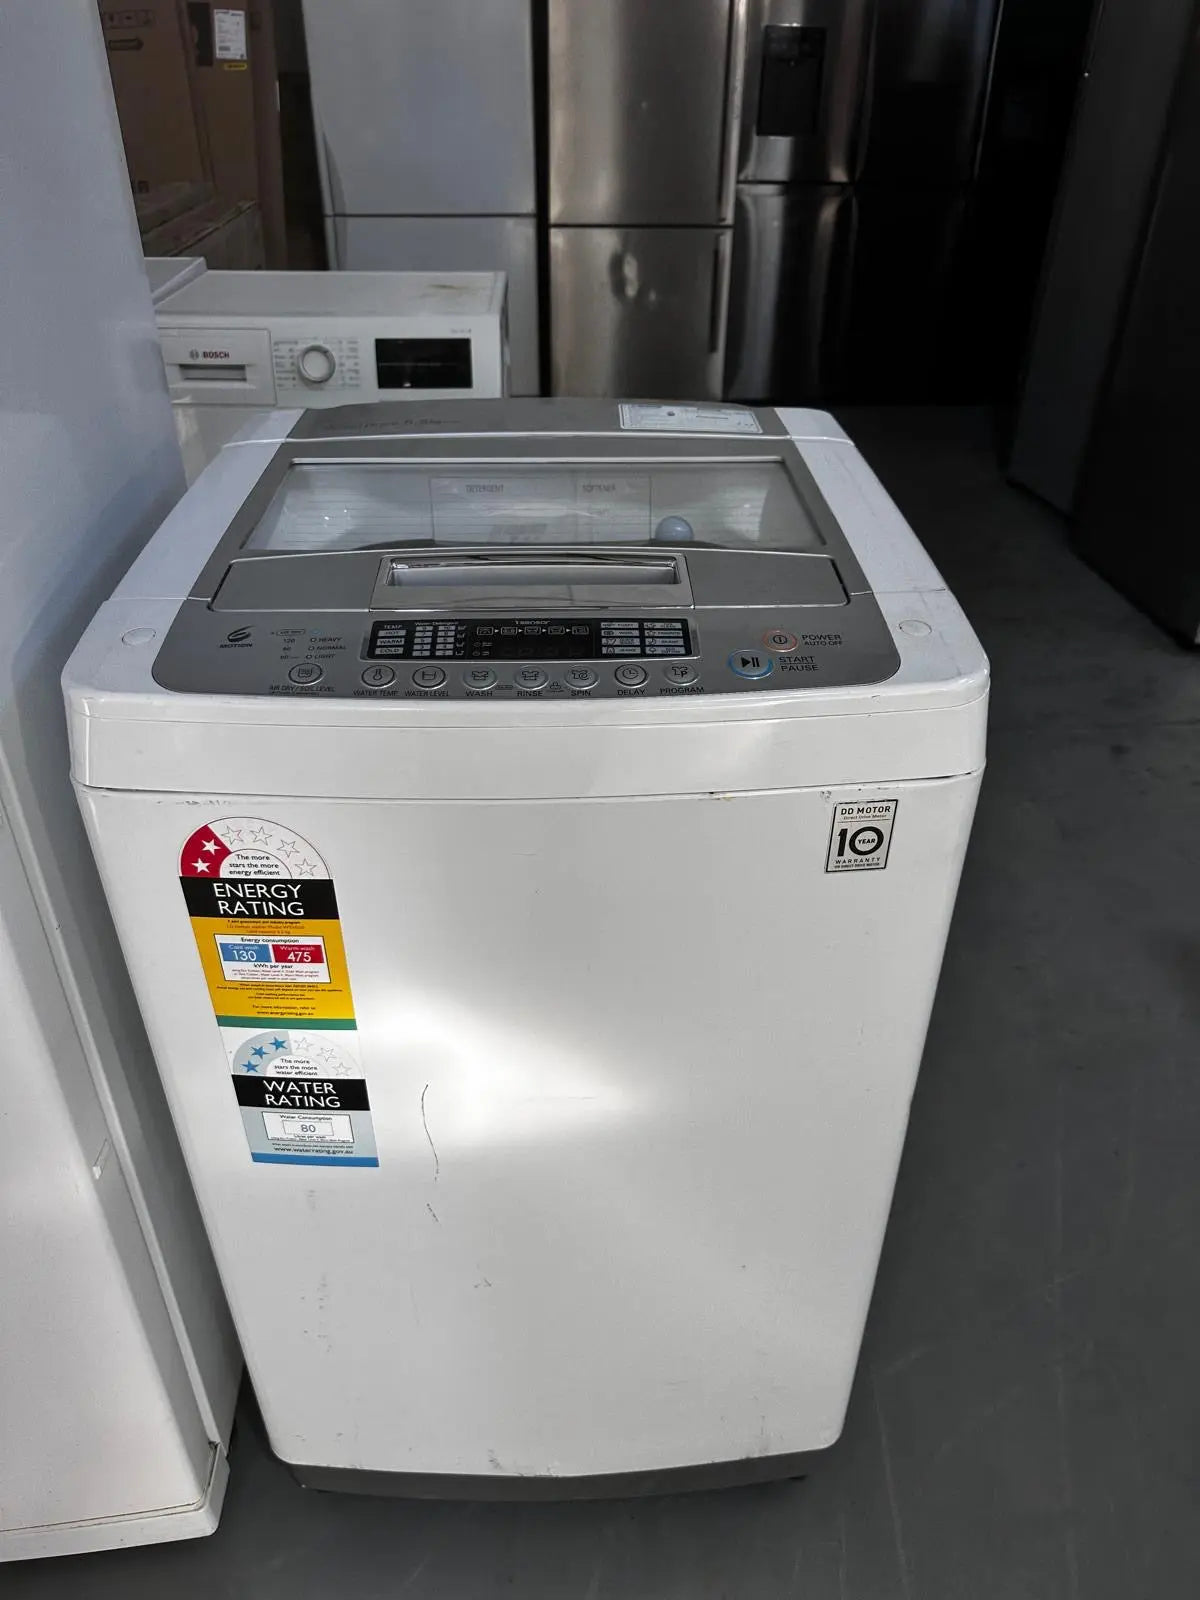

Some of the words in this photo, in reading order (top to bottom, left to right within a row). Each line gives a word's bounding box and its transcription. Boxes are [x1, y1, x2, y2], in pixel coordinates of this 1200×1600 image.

[203, 351, 230, 359] BOSCH
[781, 664, 820, 672] PAUSE
[617, 688, 646, 696] DELAY
[659, 686, 705, 695] PROGRAM
[857, 806, 891, 814] MOTOR
[837, 826, 885, 857] 10
[229, 869, 252, 877] energy
[213, 883, 302, 899] ENERGY
[218, 901, 305, 916] RATING
[233, 950, 257, 961] 130
[287, 951, 312, 962] 475
[263, 1080, 337, 1094] WATER
[265, 1094, 341, 1108] RATING
[300, 1124, 316, 1133] 80
